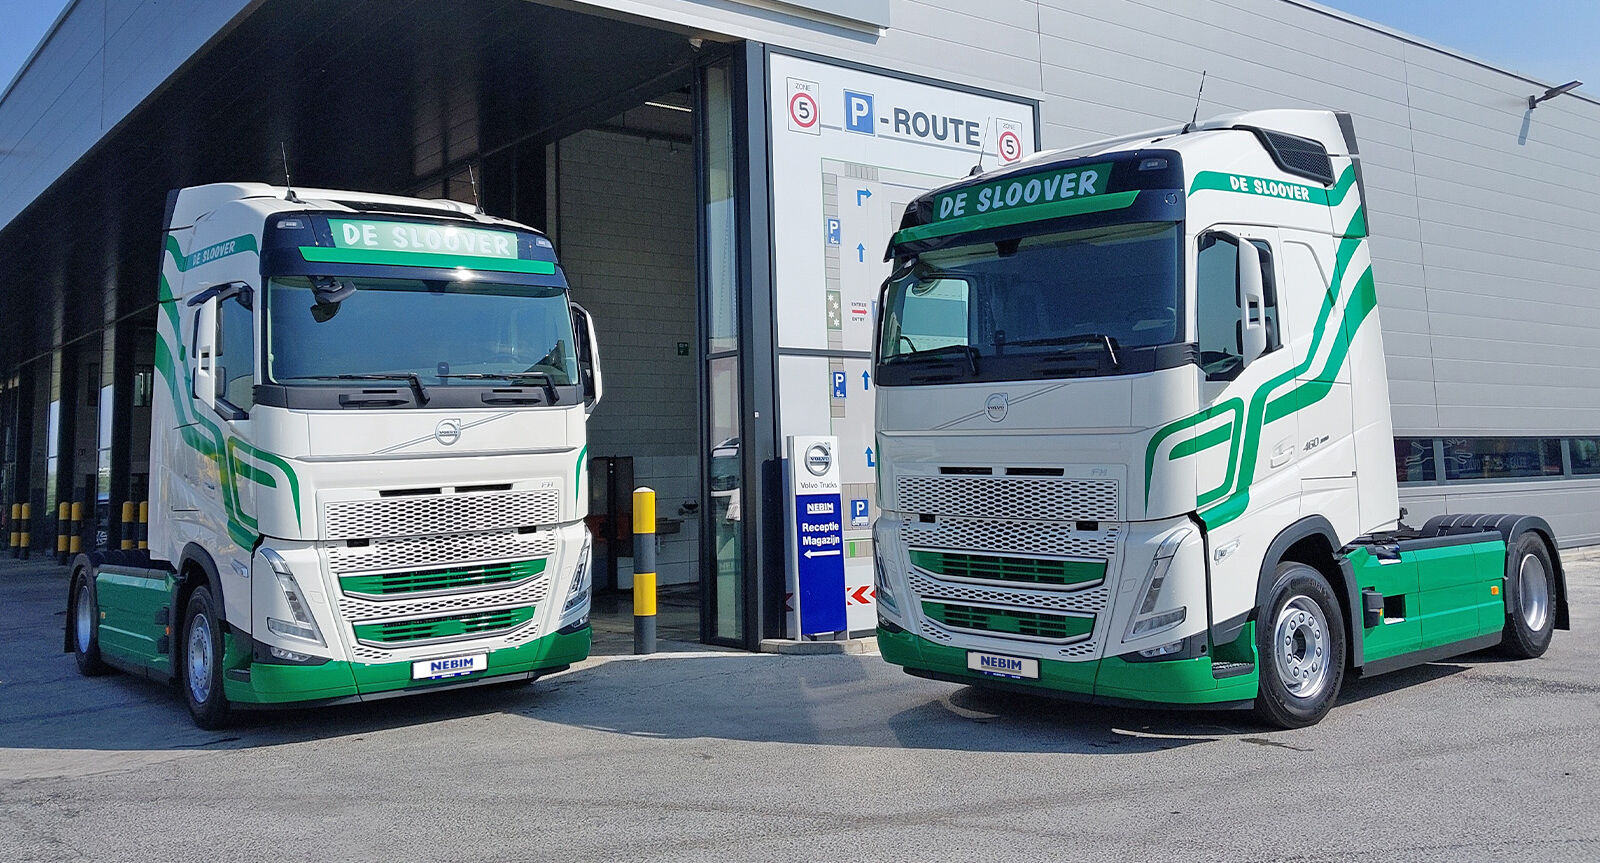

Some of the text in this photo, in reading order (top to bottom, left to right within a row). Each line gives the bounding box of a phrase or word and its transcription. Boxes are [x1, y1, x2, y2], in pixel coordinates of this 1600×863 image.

[795, 83, 811, 92] ZONE
[799, 101, 810, 119] 5
[850, 96, 869, 127] P
[1006, 139, 1015, 155] 5
[939, 169, 1099, 220] DE SLOOVER
[1229, 175, 1310, 201] DE SLOOVER
[829, 220, 839, 234] P
[342, 222, 511, 256] DE SLOOVER
[192, 240, 236, 266] DE SLOOVER
[835, 373, 845, 387] P
[1303, 436, 1319, 451] 460
[800, 481, 838, 489] Volvo Trucks
[806, 502, 834, 512] NEBIM
[856, 501, 865, 516] P
[802, 522, 840, 533] Receptie
[802, 535, 840, 547] Magazijn
[430, 657, 474, 672] NEBIM
[980, 655, 1022, 671] NEBIM
